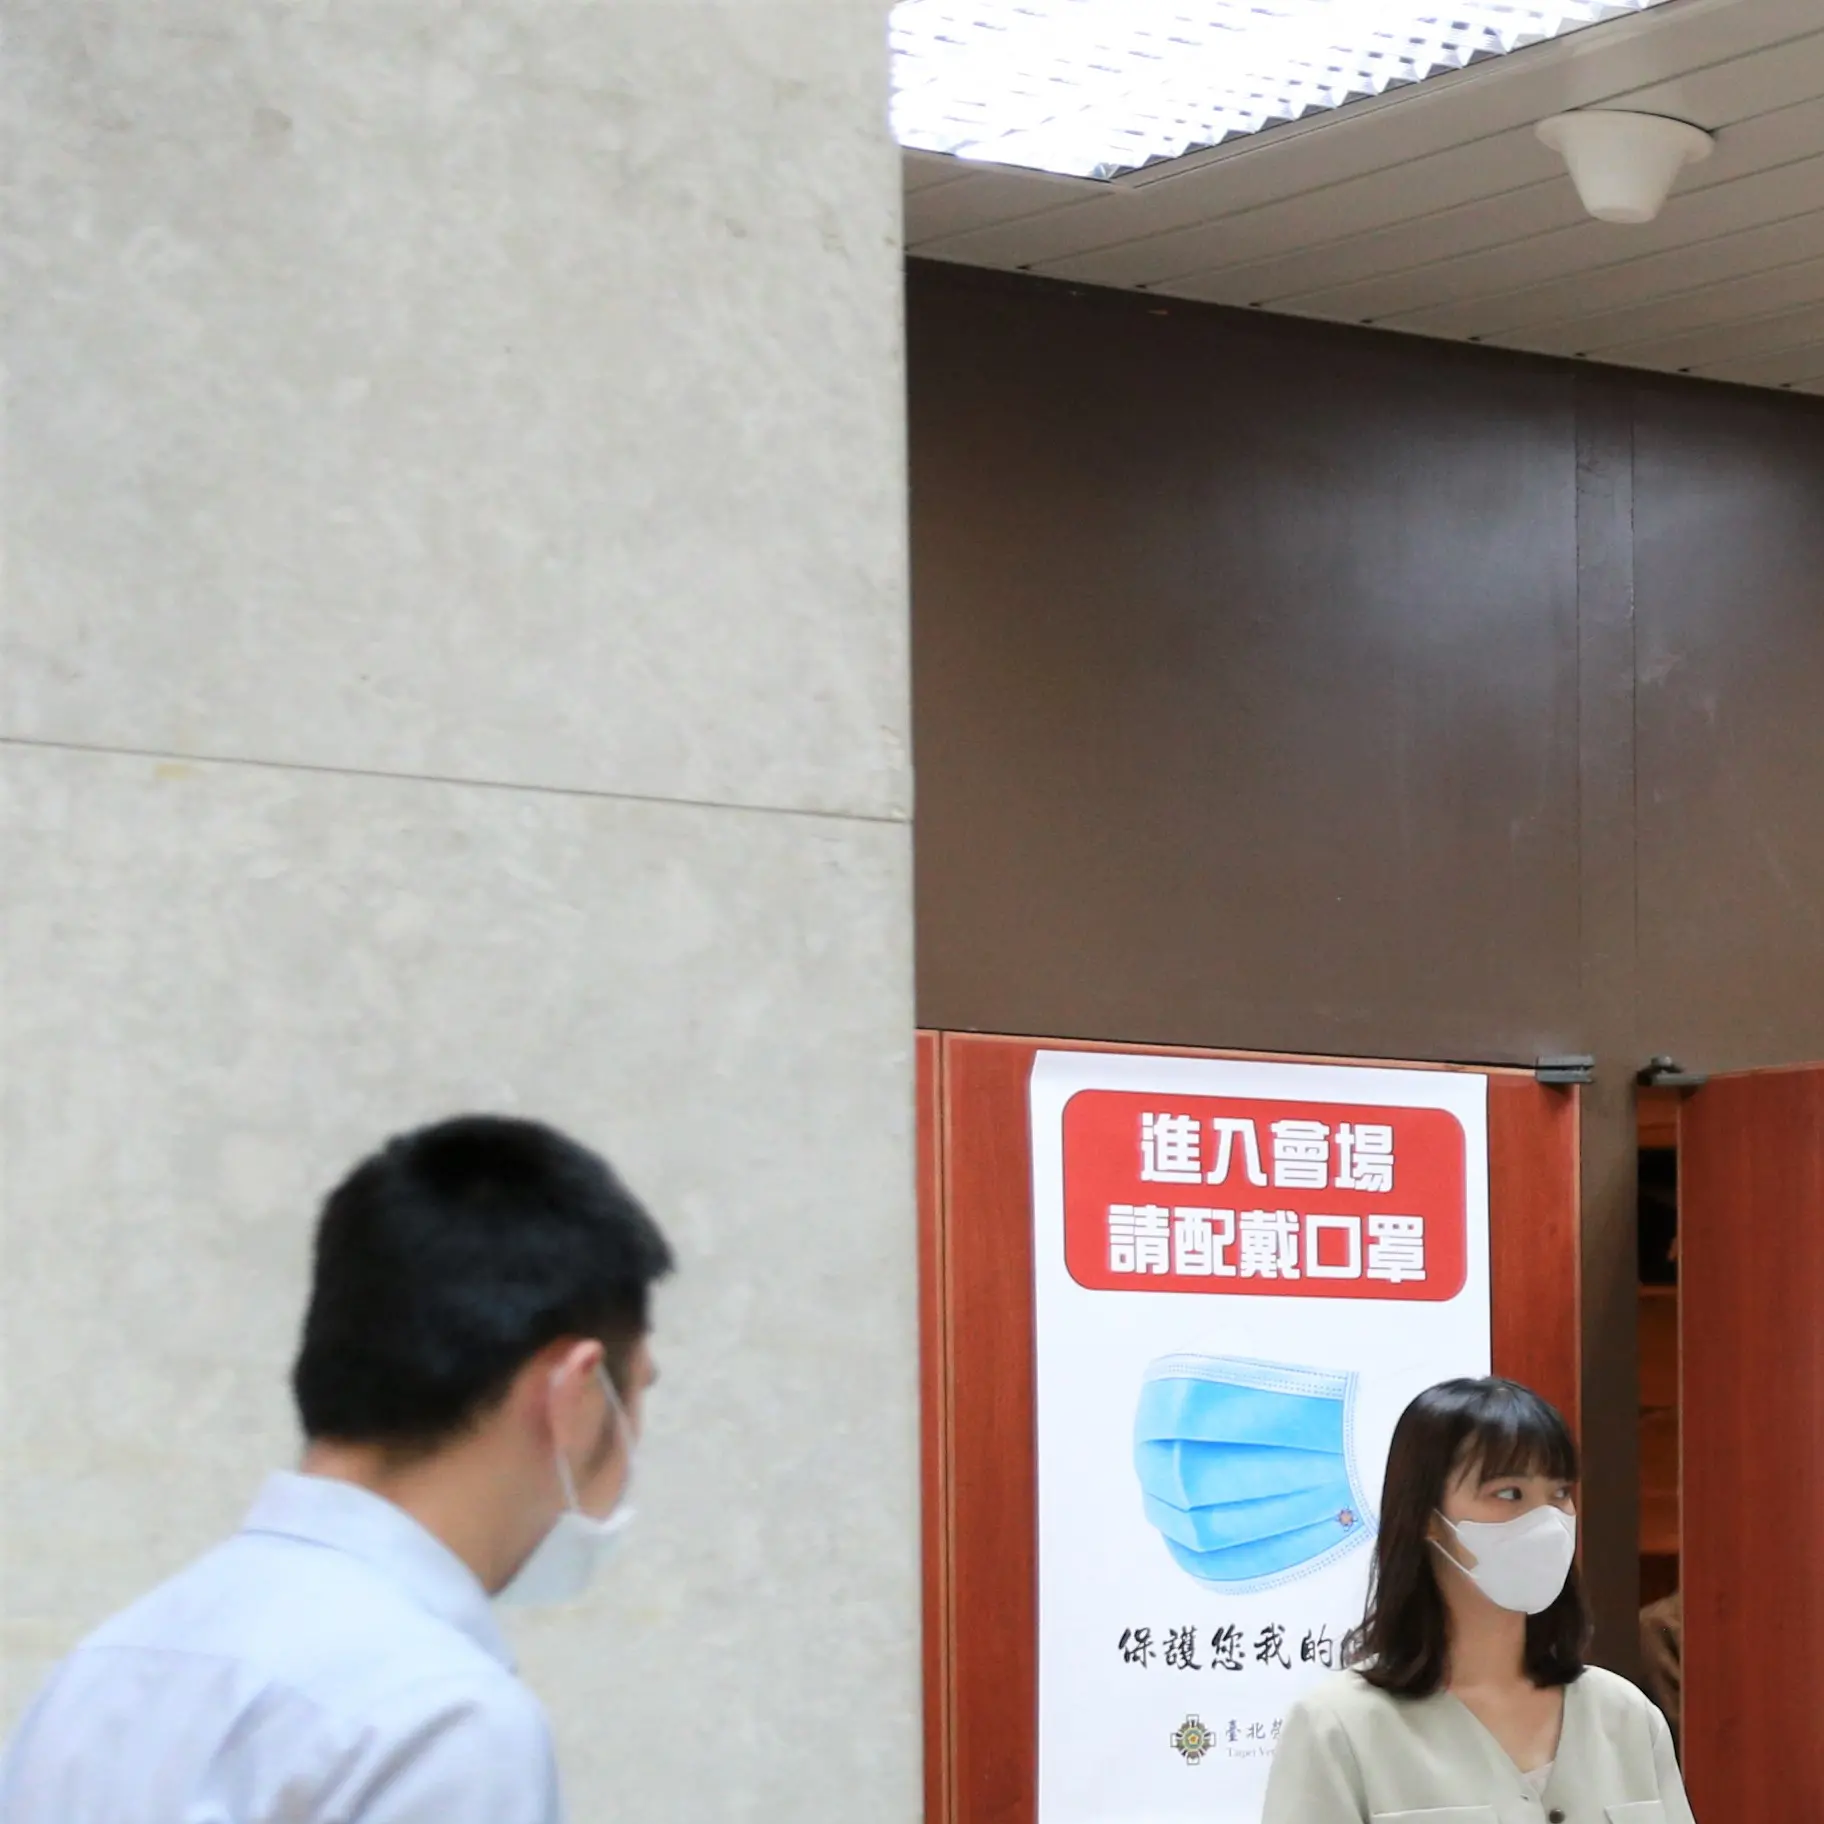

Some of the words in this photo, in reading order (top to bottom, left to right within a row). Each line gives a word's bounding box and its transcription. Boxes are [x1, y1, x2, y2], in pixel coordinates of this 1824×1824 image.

[1140, 1112, 1395, 1192] 進入會場
[1108, 1204, 1426, 1283] 請配戴口罩
[1118, 1622, 1350, 1671] 保護您我的
